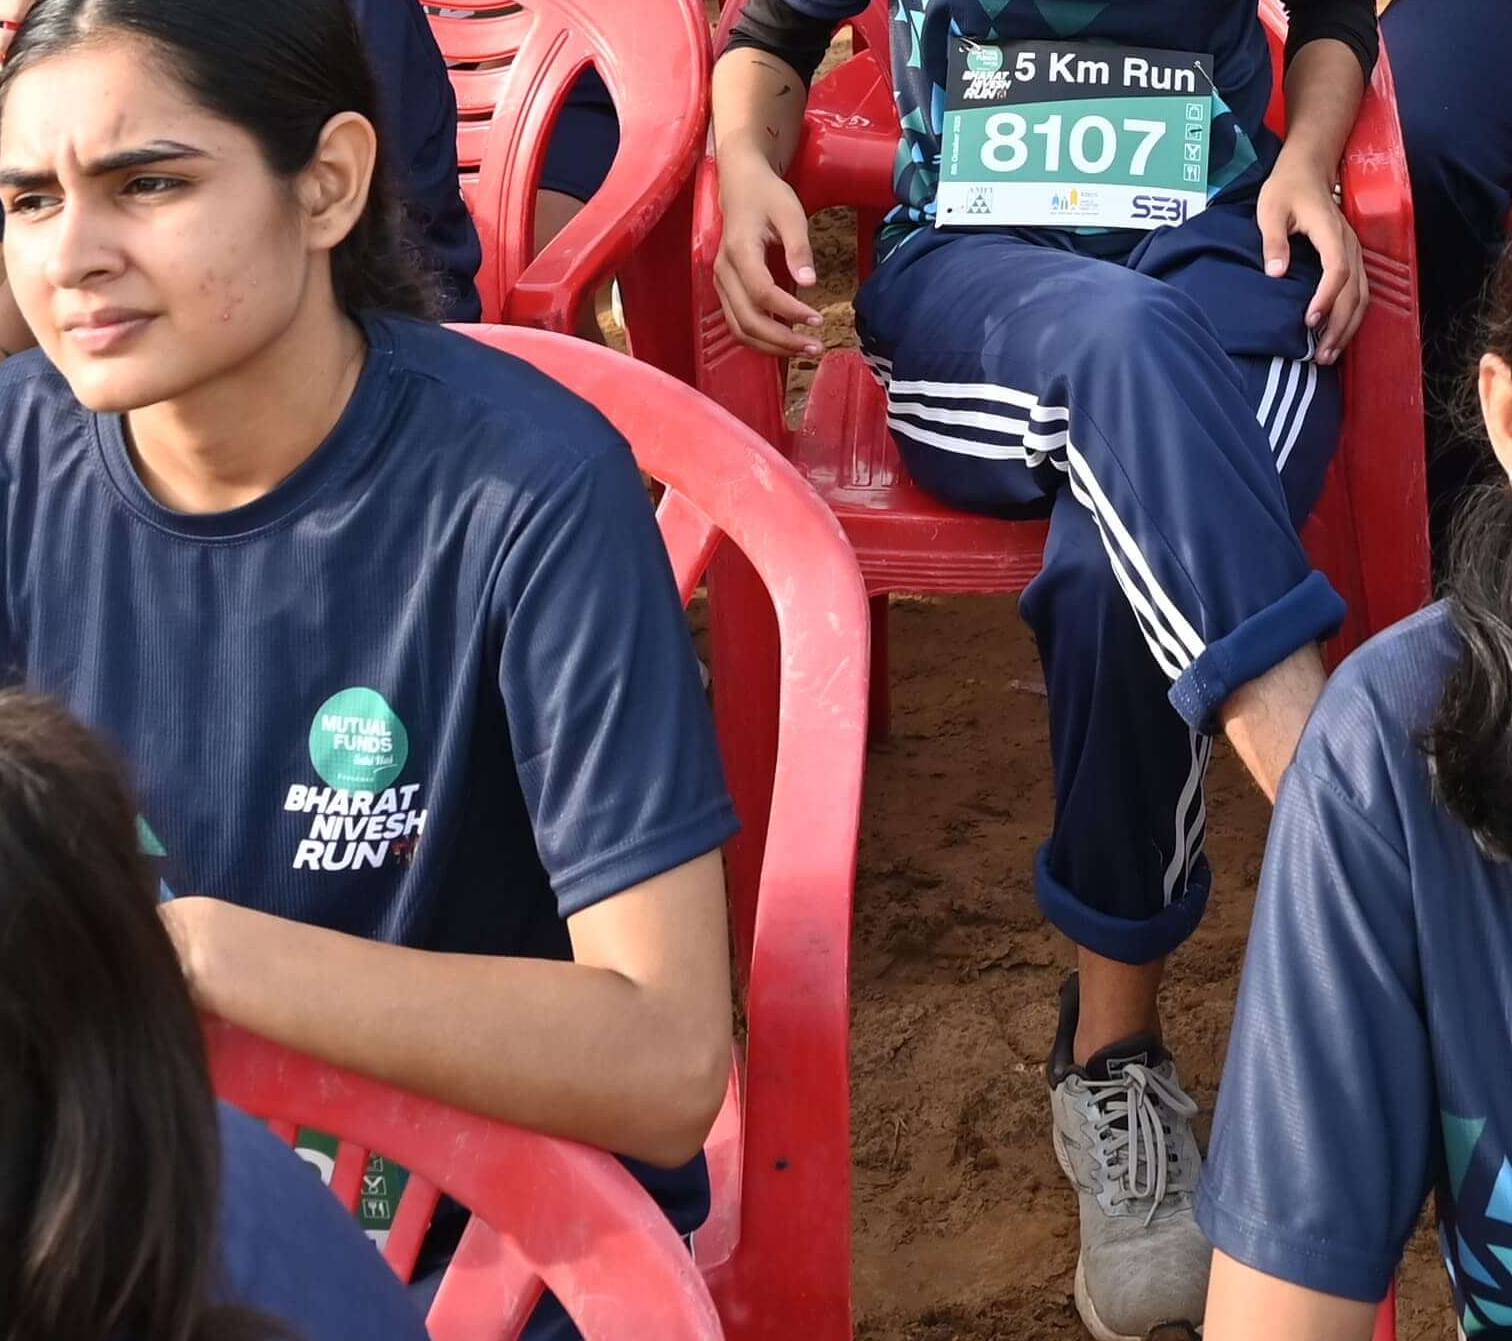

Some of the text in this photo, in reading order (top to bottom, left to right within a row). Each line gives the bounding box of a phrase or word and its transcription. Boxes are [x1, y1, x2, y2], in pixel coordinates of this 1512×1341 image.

[962, 69, 1010, 81] BHARAT
[1014, 52, 1196, 93] 5 Km Run
[963, 86, 999, 100] RUN
[979, 112, 1167, 177] 8107
[1131, 195, 1187, 222] SEBI
[320, 714, 393, 739] MUTUAL
[333, 736, 394, 756] FUNDS
[284, 783, 421, 817] BHARAT
[309, 809, 429, 841] NIVESH
[292, 839, 390, 873] RUN
